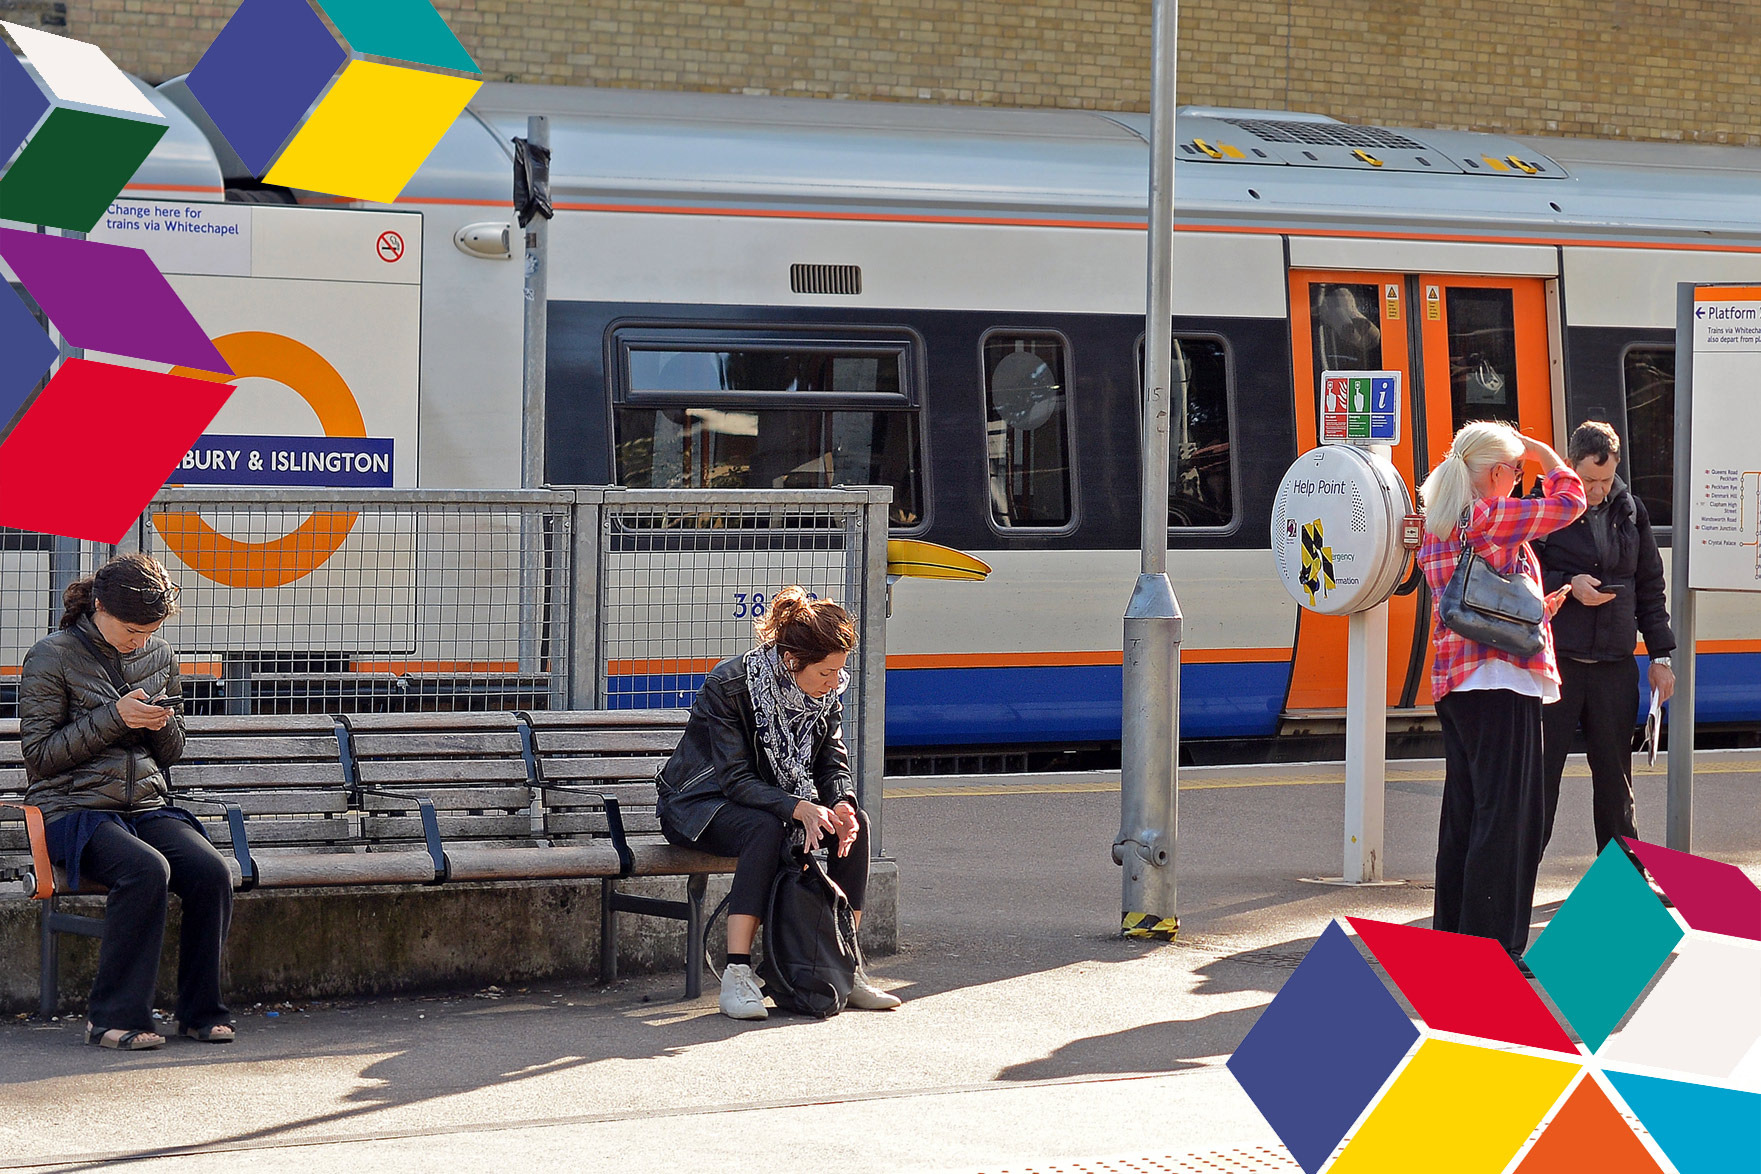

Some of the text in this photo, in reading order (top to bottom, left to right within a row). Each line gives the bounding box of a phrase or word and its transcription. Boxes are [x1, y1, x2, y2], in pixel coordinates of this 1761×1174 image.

[107, 204, 202, 218] Change here for
[106, 218, 239, 236] trains via Whitechapel
[1708, 306, 1756, 319] Platform
[1720, 336, 1739, 344] depart
[177, 449, 389, 473] BURY & ISLINGTON
[1293, 479, 1346, 498] Help Point
[1332, 553, 1355, 562] ergency
